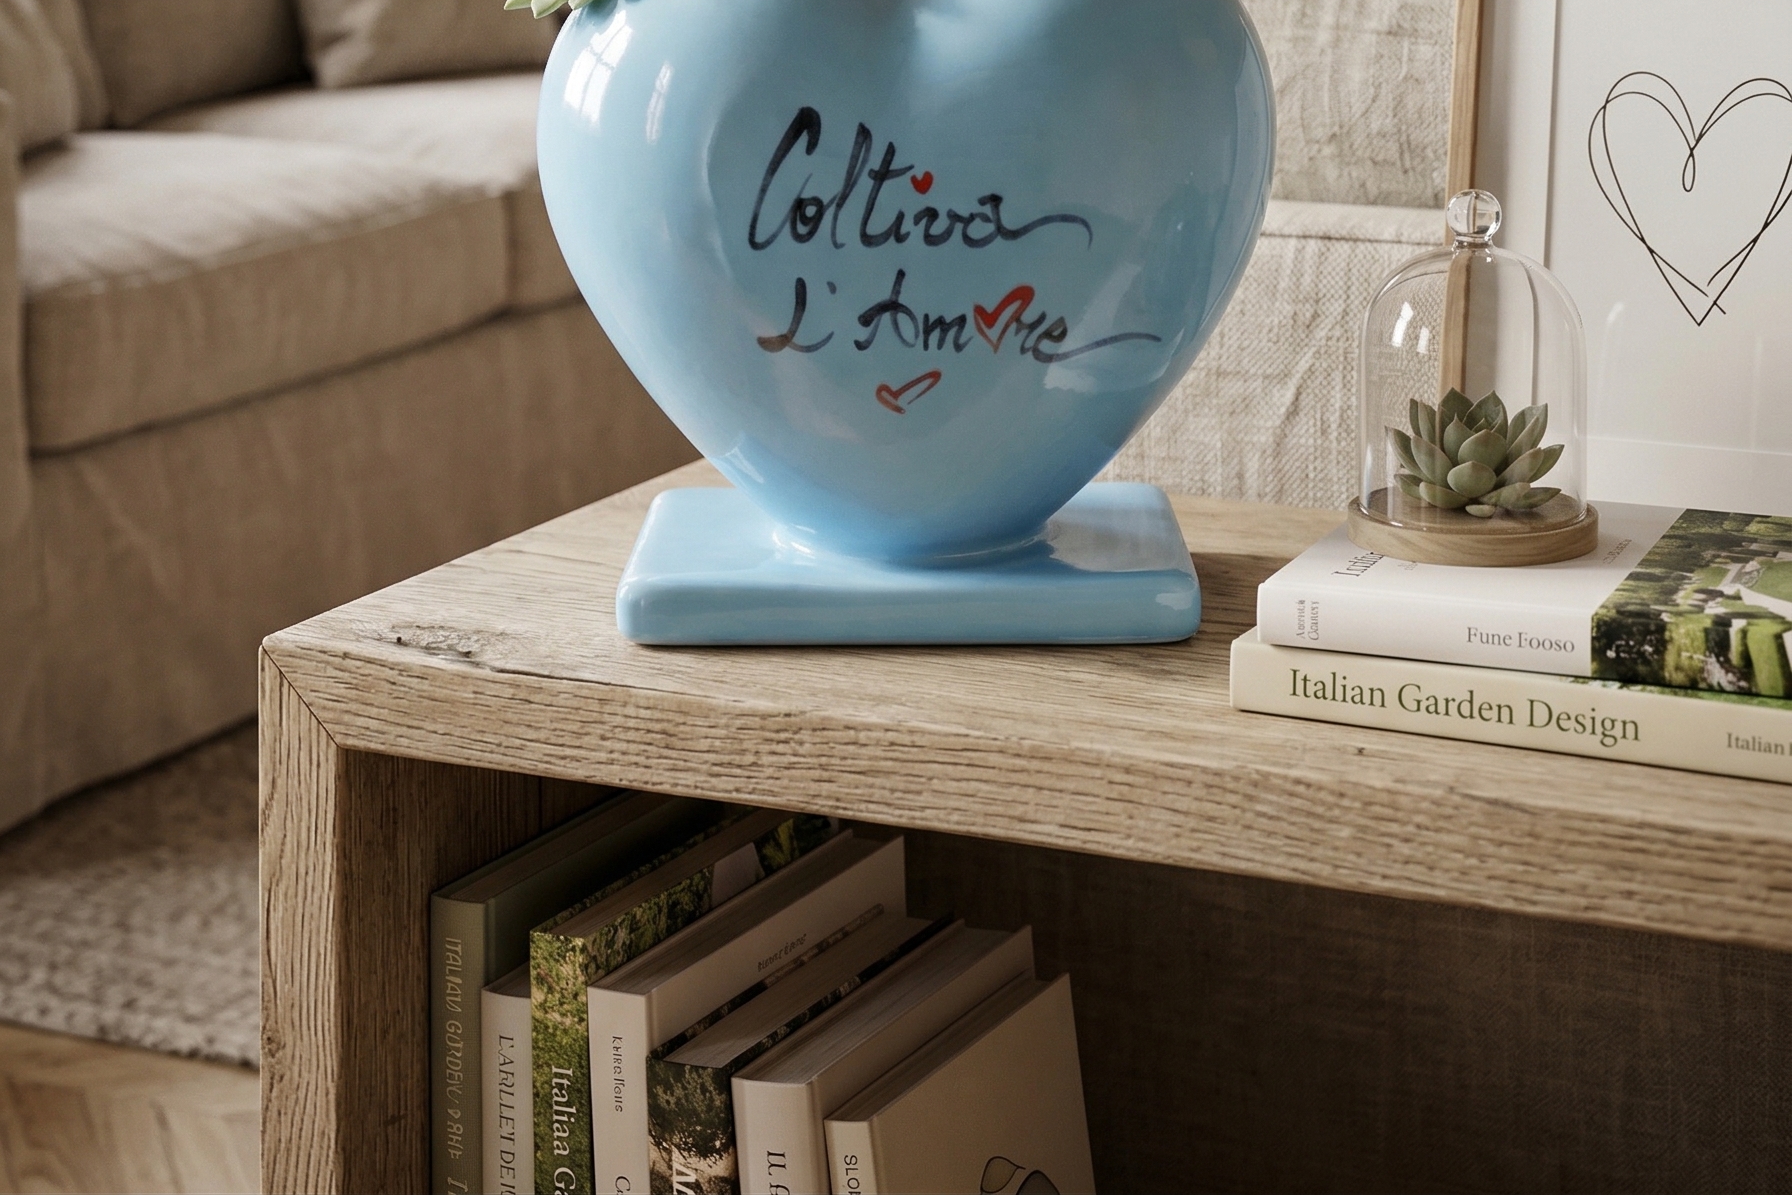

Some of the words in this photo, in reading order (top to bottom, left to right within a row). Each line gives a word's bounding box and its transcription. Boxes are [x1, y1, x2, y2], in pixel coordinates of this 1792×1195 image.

[747, 105, 1094, 252] Coltiva
[1466, 626, 1513, 647] Fune
[1289, 668, 1388, 709] Italian
[1398, 683, 1516, 727] Garden
[1527, 698, 1642, 749] Design
[1726, 732, 1785, 756] Italian
